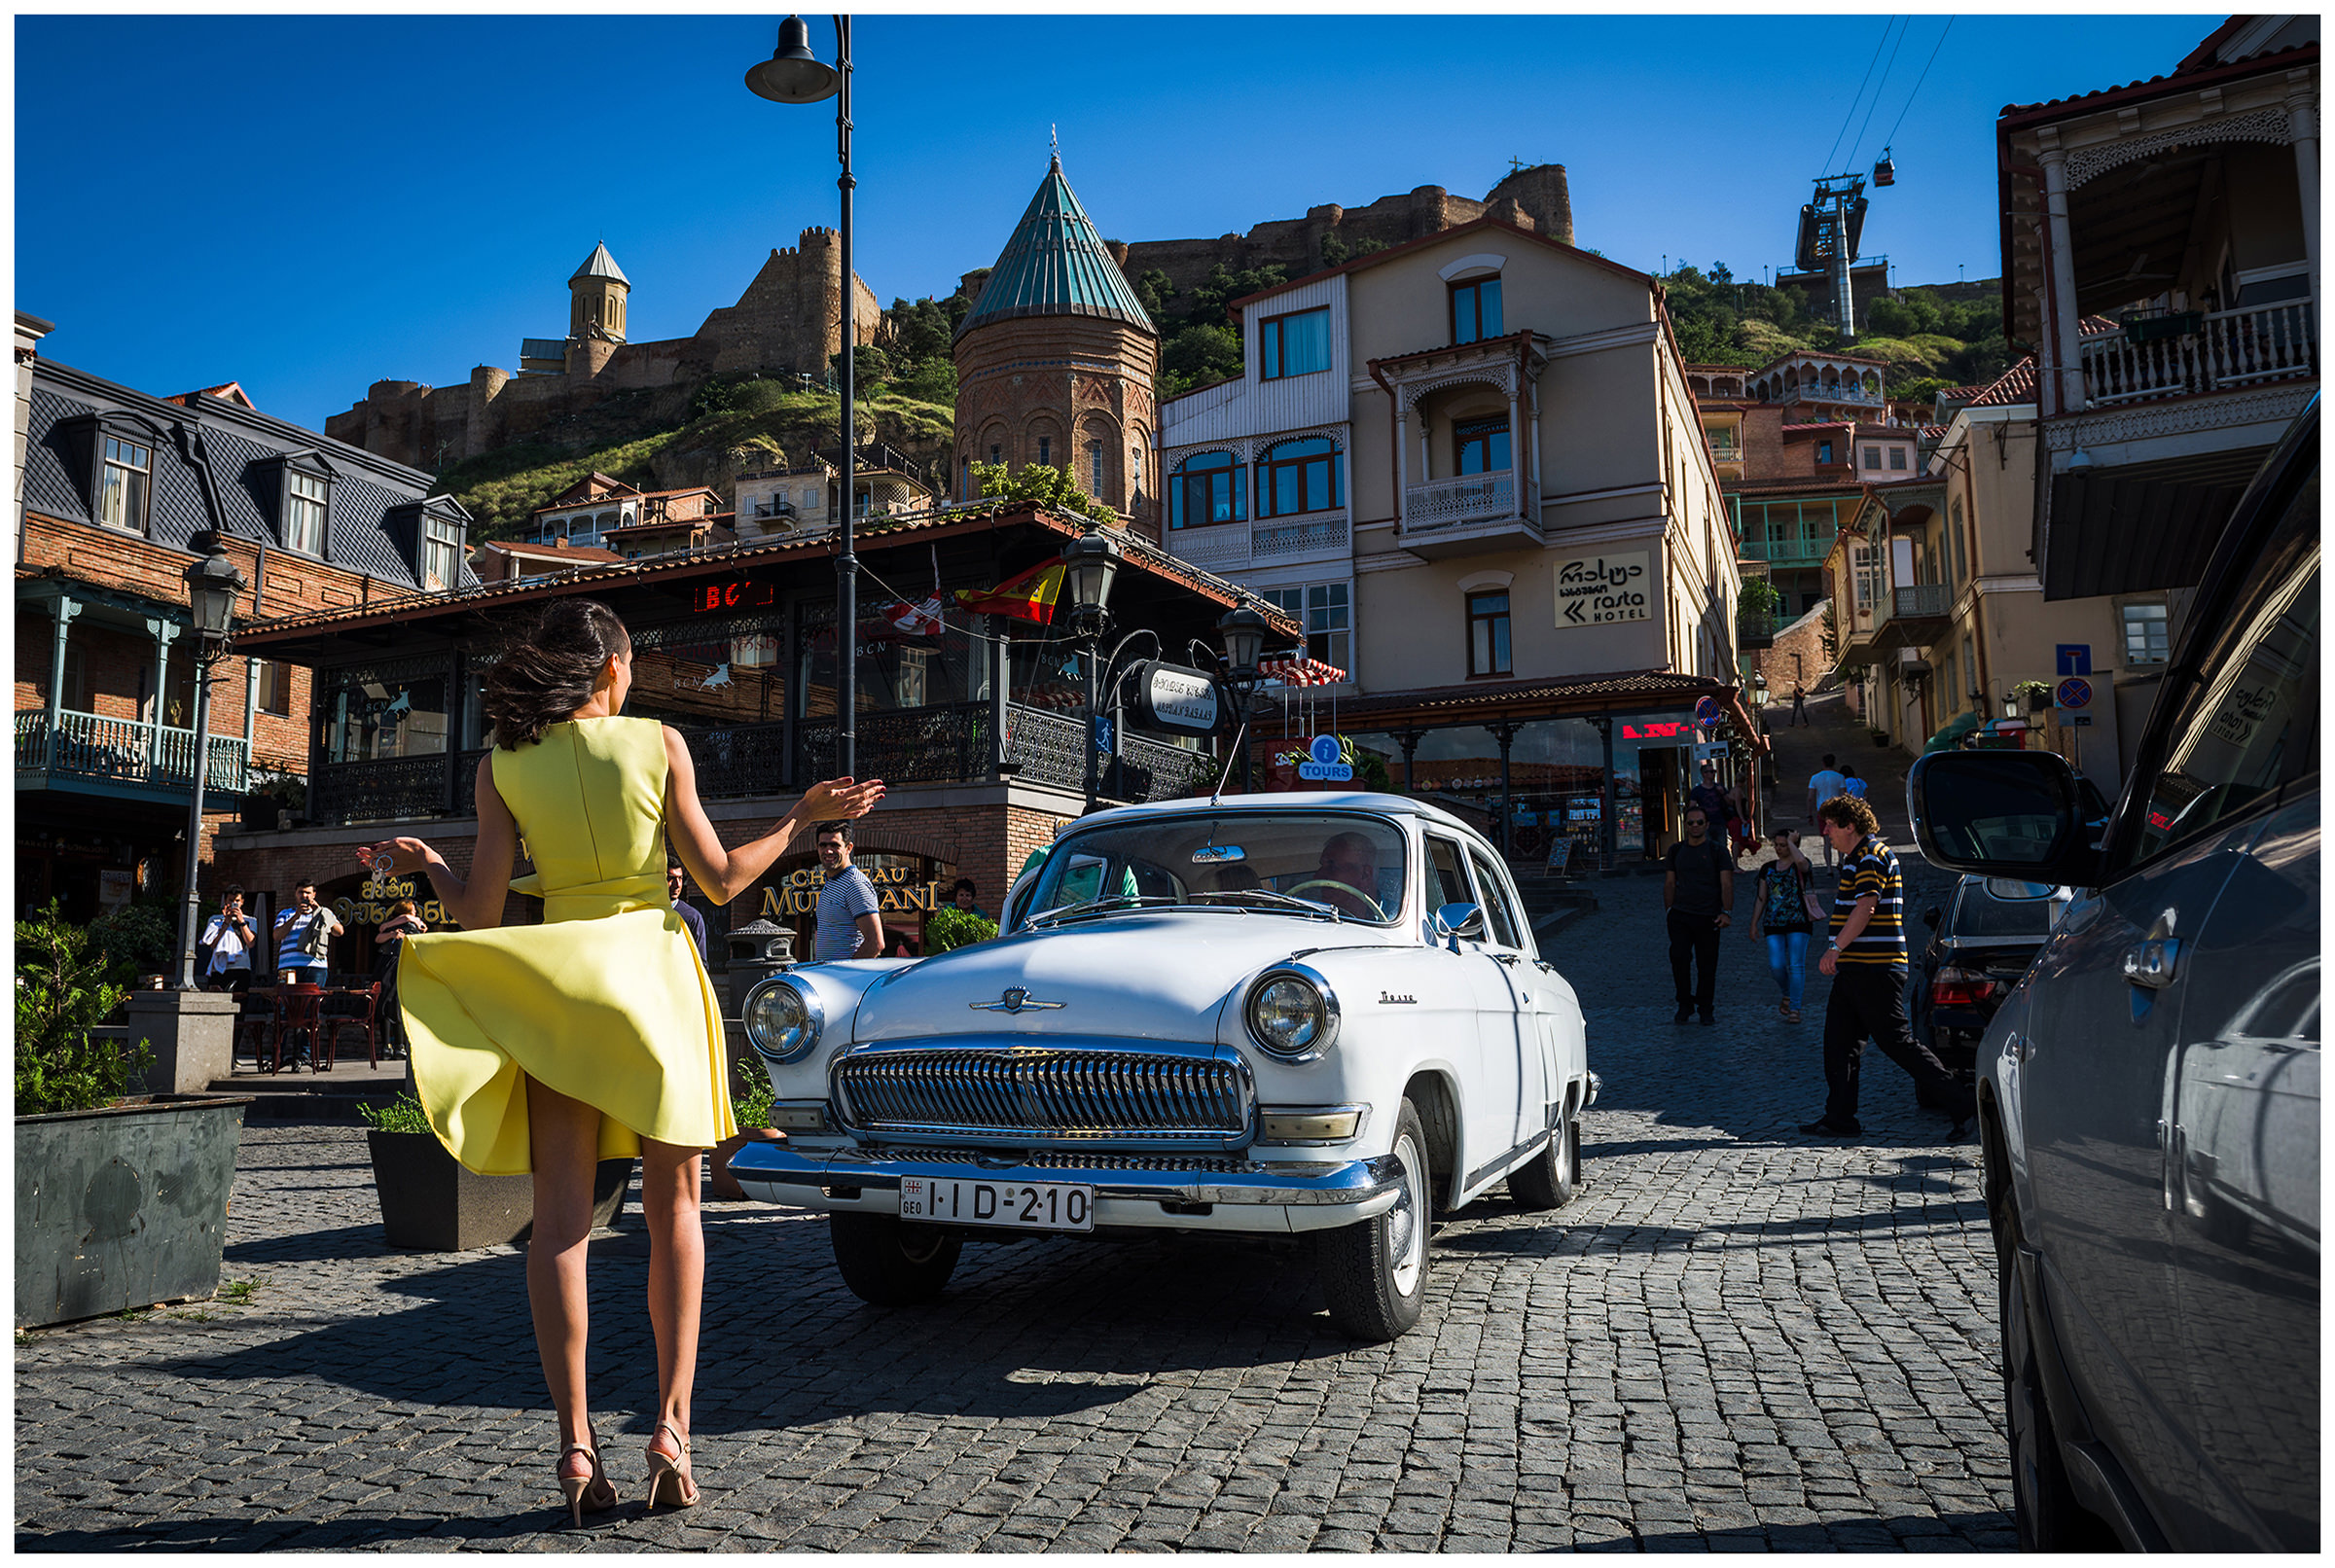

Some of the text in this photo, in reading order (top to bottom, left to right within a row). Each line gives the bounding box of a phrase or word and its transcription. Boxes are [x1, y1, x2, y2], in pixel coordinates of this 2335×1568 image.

[1594, 590, 1644, 610] rasta
[1594, 608, 1645, 623] HOTEL
[855, 641, 886, 658] BCN
[673, 676, 700, 690] BCN
[365, 700, 387, 713] BCN
[1303, 766, 1350, 777] TOURS
[791, 866, 909, 888] CHEAU
[760, 880, 940, 917] MUANI
[903, 1200, 922, 1215] GEO
